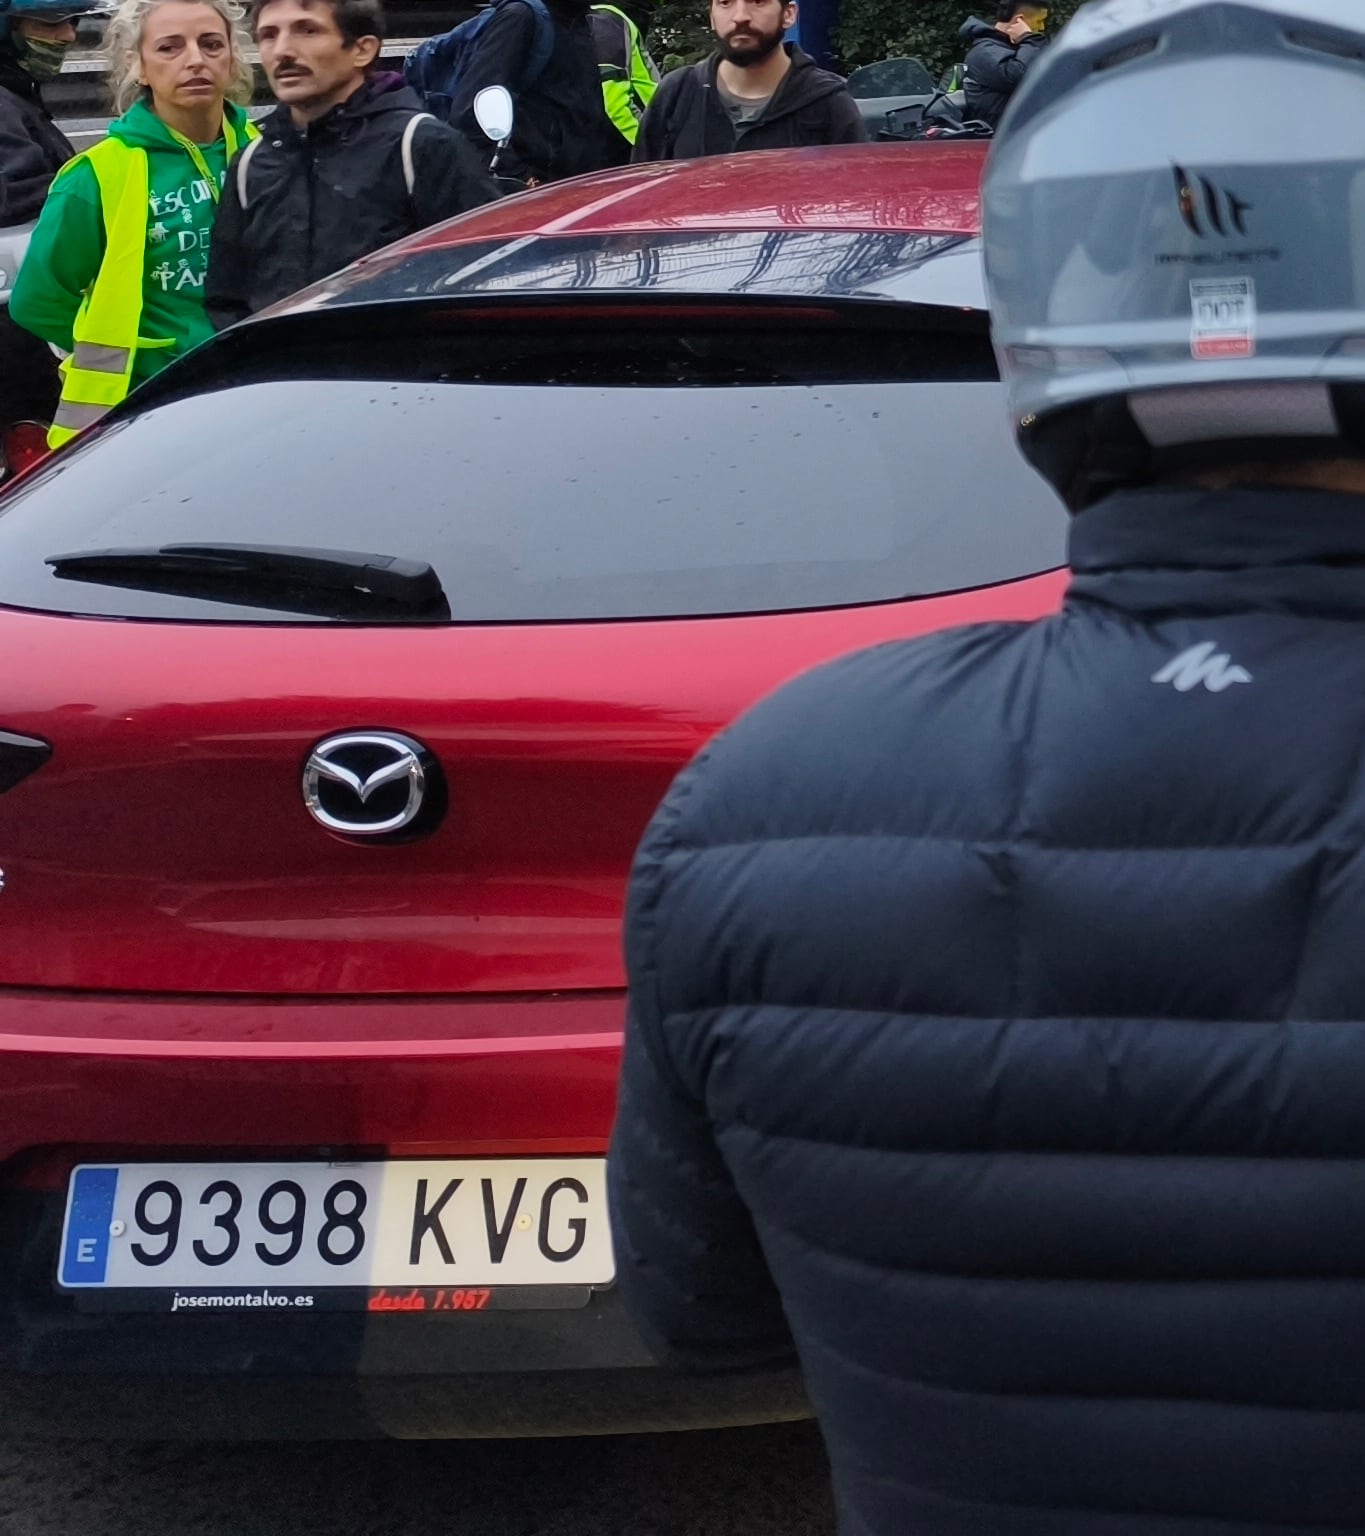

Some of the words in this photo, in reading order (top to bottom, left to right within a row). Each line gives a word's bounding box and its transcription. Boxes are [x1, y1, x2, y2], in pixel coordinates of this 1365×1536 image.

[129, 1177, 369, 1268] 9398
[408, 1177, 590, 1266] KVG
[75, 1238, 97, 1263] E
[171, 1289, 315, 1312] josemontalvo.es
[368, 1288, 426, 1311] desde
